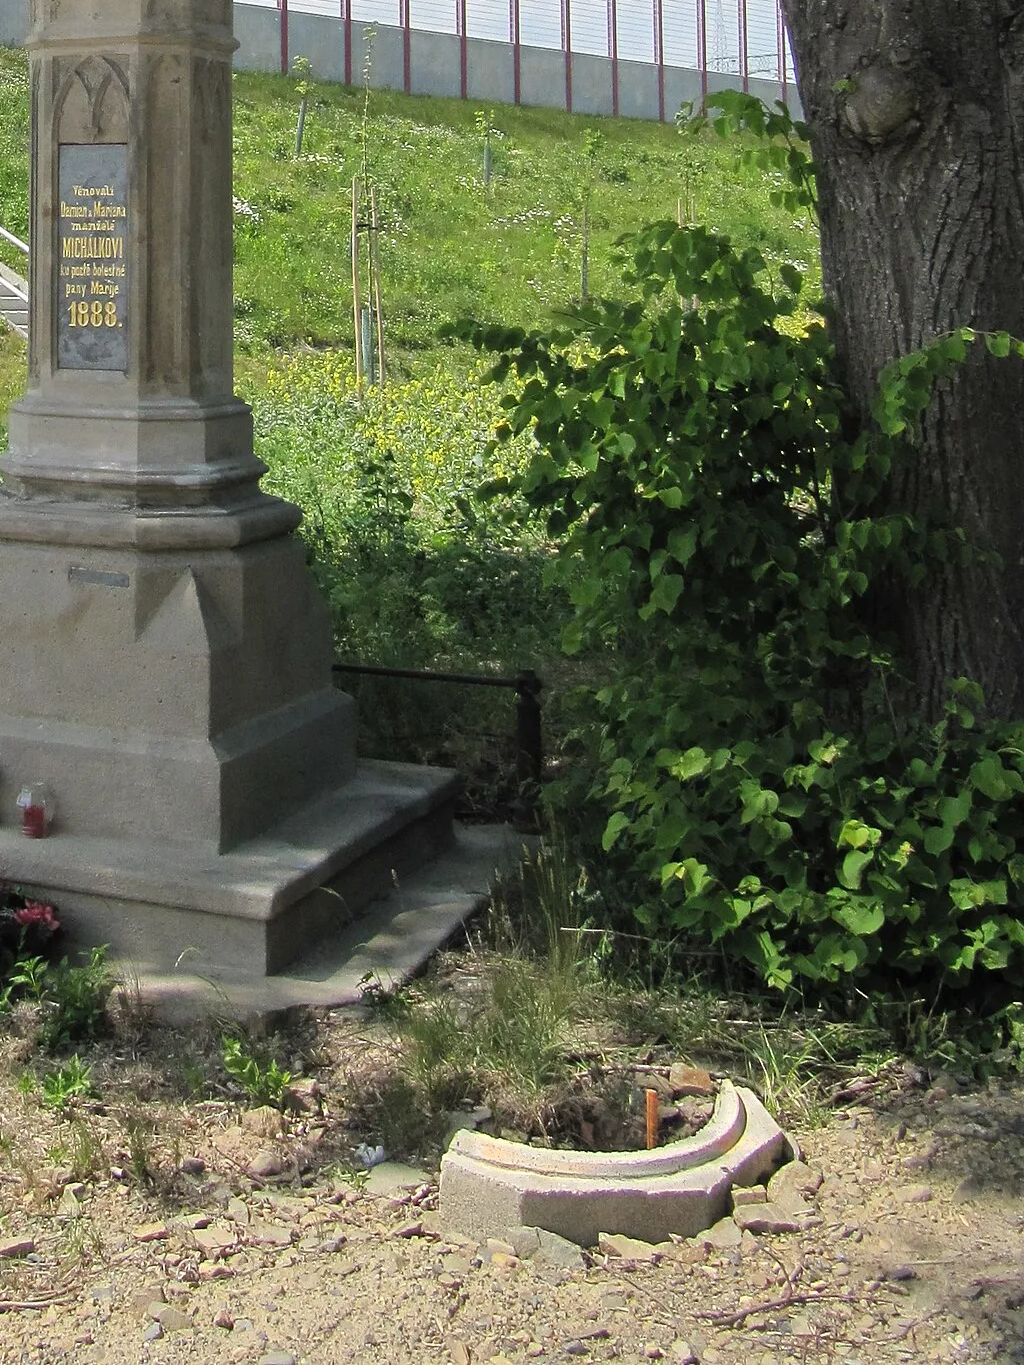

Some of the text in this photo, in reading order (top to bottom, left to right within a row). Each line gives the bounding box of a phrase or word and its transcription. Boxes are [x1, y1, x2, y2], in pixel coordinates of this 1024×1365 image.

[62, 233, 123, 259] MICHÁLKOVI
[92, 262, 126, 277] bolestné
[67, 300, 123, 328] 1888.
